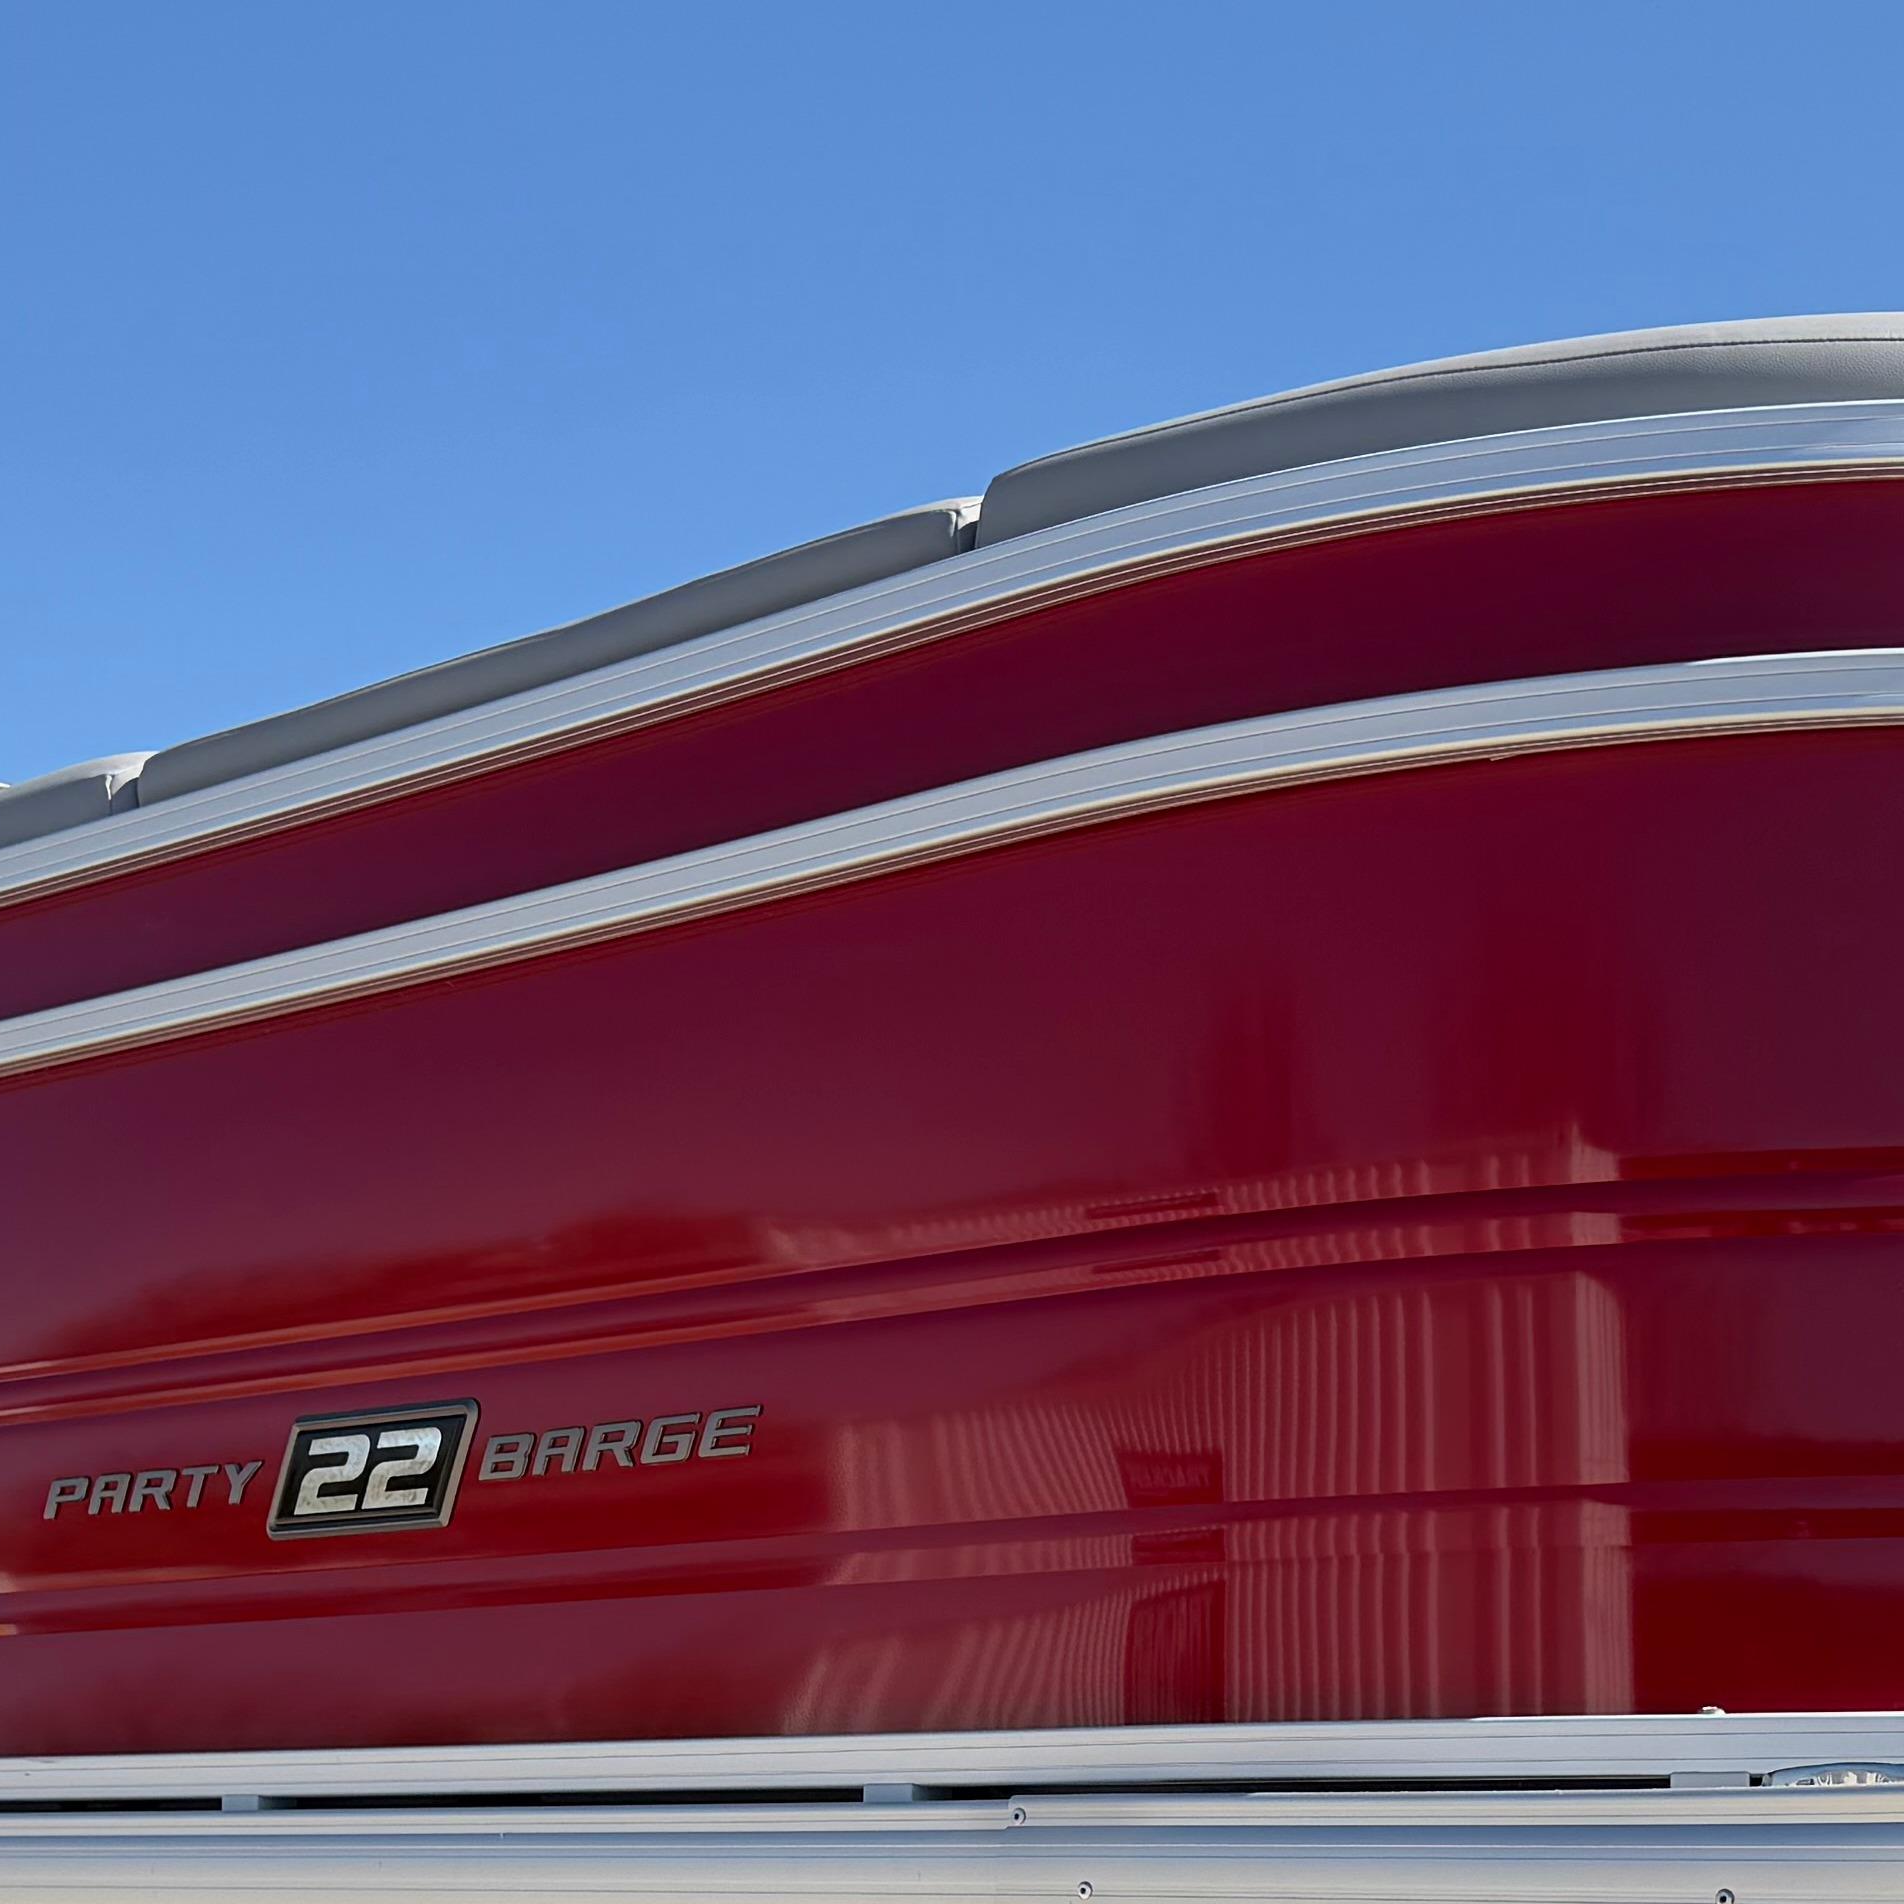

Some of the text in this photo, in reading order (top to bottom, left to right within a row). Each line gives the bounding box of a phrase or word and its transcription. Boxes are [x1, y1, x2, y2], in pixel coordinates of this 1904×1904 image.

[43, 1404, 762, 1520] PARTY 22 BARGE
